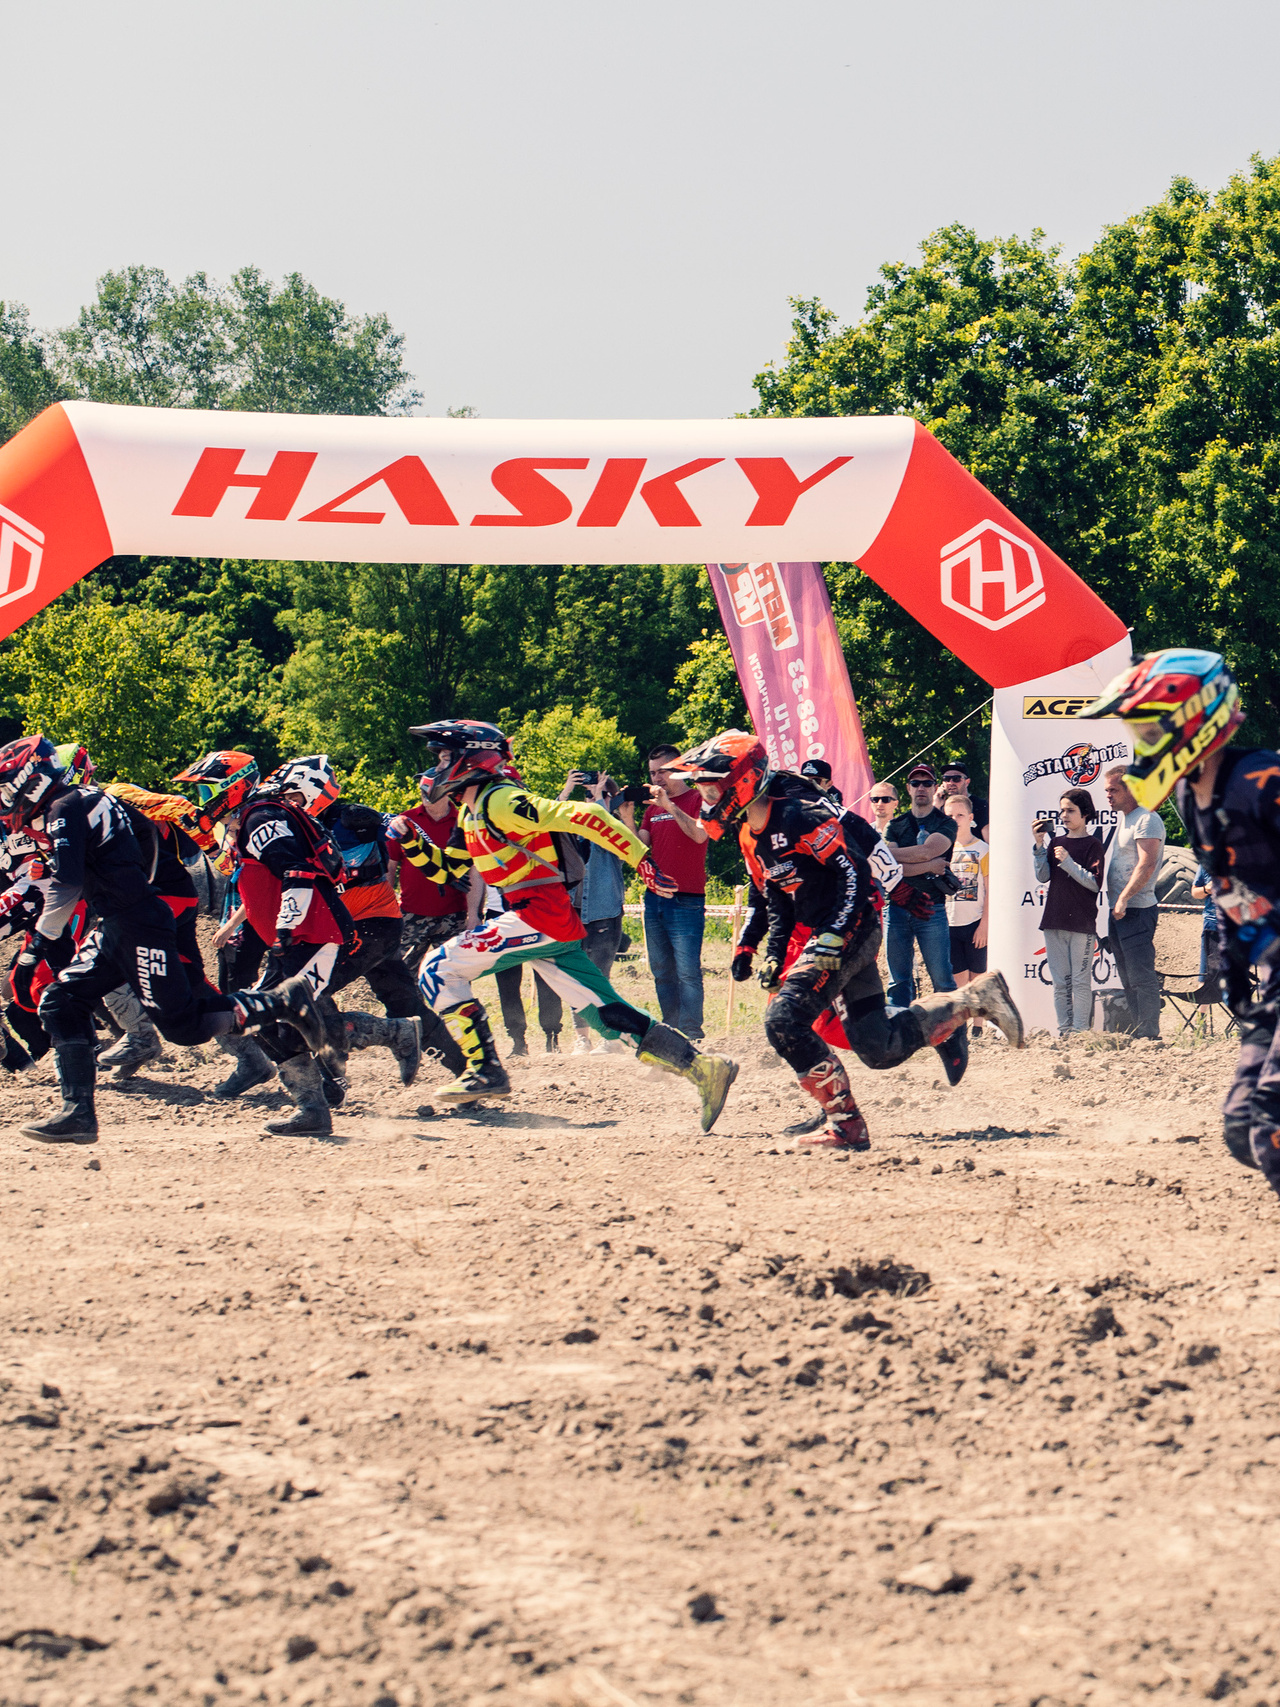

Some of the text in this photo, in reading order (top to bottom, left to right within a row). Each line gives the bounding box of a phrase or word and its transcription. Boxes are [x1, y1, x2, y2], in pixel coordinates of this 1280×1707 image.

[172, 447, 853, 527] HASKY
[1025, 699, 1097, 716] ACE
[1034, 754, 1082, 776] START
[150, 948, 167, 977] 23
